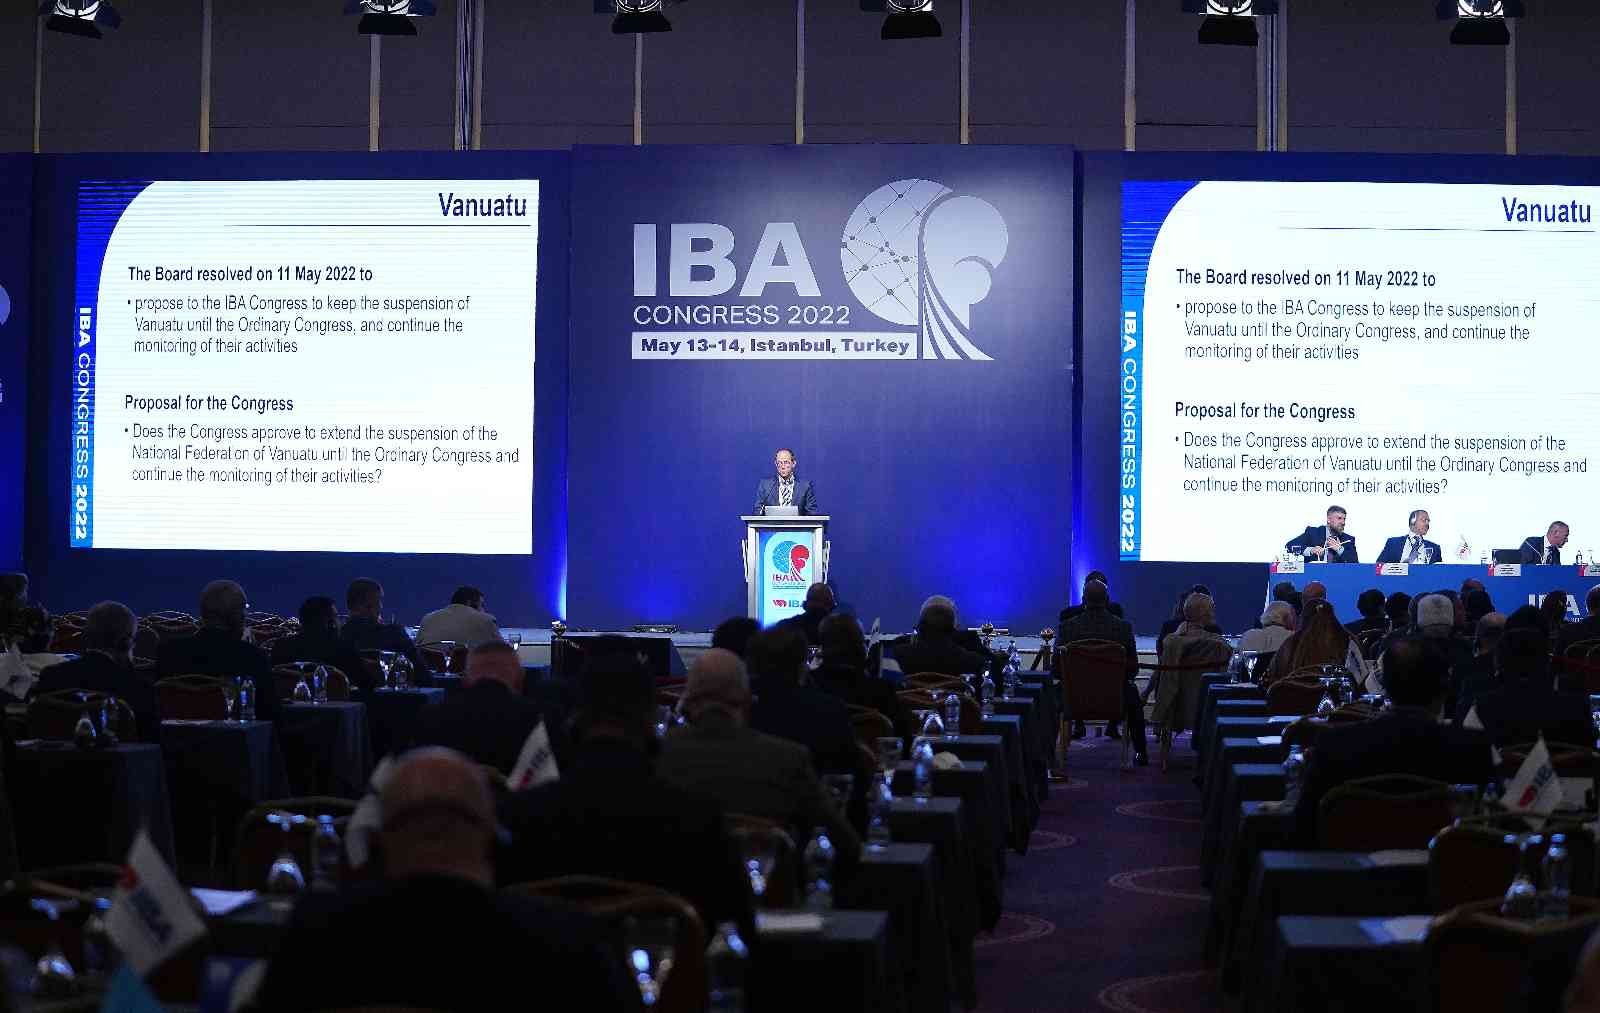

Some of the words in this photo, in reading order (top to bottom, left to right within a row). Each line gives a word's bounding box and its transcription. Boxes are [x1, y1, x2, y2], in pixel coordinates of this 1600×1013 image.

[439, 193, 527, 217] Vanuatu
[1502, 197, 1591, 223] Vanuatu
[633, 222, 821, 297] IBA
[128, 266, 150, 280] The
[156, 266, 192, 280] Board
[197, 266, 252, 280] resolved
[257, 269, 273, 280] on
[277, 266, 290, 280] 11
[295, 266, 321, 284] May
[326, 266, 356, 280] 2022
[360, 267, 372, 280] to
[1176, 269, 1200, 284] The
[1206, 269, 1246, 284] Board
[1252, 270, 1309, 285] resolved
[1315, 273, 1331, 285] on
[1337, 271, 1349, 285] 11
[1356, 271, 1382, 290] May
[1387, 271, 1418, 286] 2022
[1423, 273, 1436, 286] to
[135, 299, 183, 313] propose
[188, 297, 198, 309] to
[202, 295, 220, 309] the
[226, 295, 246, 309] IBA
[250, 295, 307, 313] Congress
[312, 297, 322, 309] to
[327, 295, 356, 313] keep
[361, 295, 380, 309] the
[384, 296, 453, 313] suspension
[458, 296, 470, 309] of
[1185, 302, 1237, 317] propose
[1242, 301, 1252, 314] to
[1258, 300, 1277, 314] the
[1282, 300, 1303, 314] IBA
[1308, 300, 1368, 319] Congress
[1373, 302, 1384, 315] to
[1390, 301, 1419, 319] keep
[1424, 302, 1443, 316] the
[1448, 303, 1519, 319] suspension
[1524, 303, 1536, 317] of
[135, 317, 183, 331] Vanuatu
[188, 317, 211, 331] until
[216, 317, 233, 331] the
[239, 317, 290, 335] Ordinary
[295, 317, 356, 335] Congress,
[361, 318, 383, 331] and
[388, 317, 440, 332] continue
[444, 318, 463, 332] the
[633, 305, 780, 326] CONGRESS
[787, 305, 850, 325] 2022
[79, 308, 91, 347] IBA
[1124, 311, 1136, 352] IBA
[1185, 321, 1236, 336] Vanuatu
[1242, 322, 1267, 336] until
[1272, 322, 1291, 336] the
[1297, 322, 1350, 341] Ordinary
[1356, 323, 1420, 341] Congress,
[1424, 324, 1447, 338] and
[1453, 324, 1505, 339] continue
[1510, 325, 1529, 339] the
[135, 340, 196, 356] monitoring
[201, 338, 212, 352] of
[216, 338, 242, 352] their
[246, 339, 297, 352] activities
[641, 339, 681, 355] May
[687, 338, 744, 354] 13-14,
[750, 338, 836, 354] Istanbul,
[842, 338, 909, 355] Turkey
[1185, 344, 1251, 362] monitoring
[1257, 344, 1268, 359] of
[1272, 344, 1300, 359] their
[1304, 345, 1359, 359] activities
[125, 395, 181, 412] Proposal
[186, 395, 201, 410] for
[207, 396, 227, 410] the
[231, 395, 294, 414] Congress
[1176, 402, 1236, 420] Proposal
[1241, 403, 1260, 417] for
[1264, 403, 1284, 418] the
[1290, 403, 1355, 422] Congress
[76, 353, 90, 479] CONGRESS
[1121, 358, 1137, 489] CONGRESS
[133, 423, 163, 438] Does
[168, 424, 186, 438] the
[190, 424, 248, 442] Congress
[252, 428, 300, 442] approve
[305, 426, 315, 439] to
[321, 425, 360, 439] extend
[366, 425, 384, 439] the
[388, 426, 458, 443] suspension
[463, 426, 474, 440] of
[478, 426, 497, 440] the
[1184, 432, 1217, 446] Does
[1222, 432, 1241, 447] the
[1246, 432, 1306, 451] Congress
[1312, 436, 1363, 451] approve
[1367, 435, 1379, 449] to
[1384, 434, 1425, 449] extend
[1431, 435, 1449, 449] the
[1454, 436, 1525, 453] suspension
[1531, 436, 1542, 450] of
[1546, 436, 1565, 450] the
[132, 445, 181, 460] National
[186, 445, 249, 460] Federaton
[254, 446, 265, 460] of
[270, 446, 317, 460] Vanuatu
[352, 447, 370, 461] the
[375, 447, 427, 465] Ordinary
[432, 447, 492, 466] Congress
[496, 448, 519, 462] and
[1184, 454, 1236, 469] National
[1241, 455, 1308, 469] Federation
[1314, 455, 1325, 469] of
[1329, 455, 1382, 471] Vanuatu
[1387, 456, 1412, 470] until
[1416, 457, 1436, 470] the
[1441, 456, 1494, 475] Ordinary
[1500, 457, 1559, 476] Congress
[1564, 458, 1586, 472] and
[132, 467, 182, 480] continue
[187, 467, 204, 480] the
[210, 467, 271, 485] monitoring
[276, 469, 288, 481] of
[291, 468, 317, 482] their
[322, 468, 382, 483] activities?
[1184, 477, 1238, 491] continue
[1242, 477, 1261, 491] the
[1267, 477, 1332, 496] monitoring
[1338, 478, 1349, 492] of
[1354, 478, 1381, 493] their
[1385, 479, 1448, 493] activities?
[76, 485, 87, 540] 2022
[1121, 496, 1135, 552] 2022
[1529, 594, 1580, 615] IA
